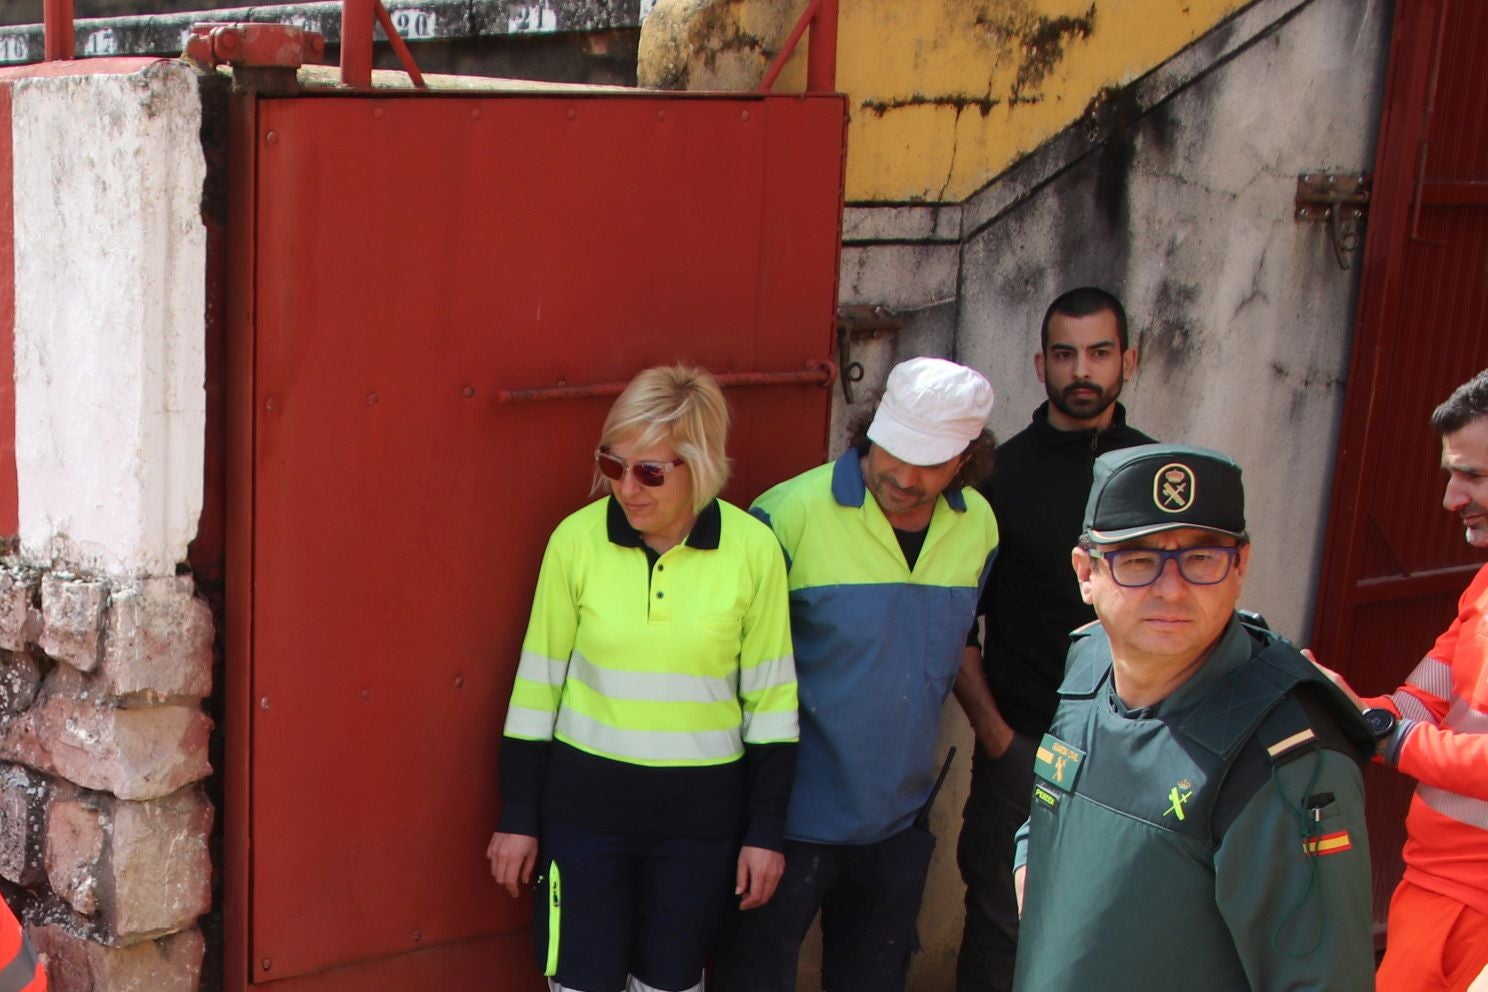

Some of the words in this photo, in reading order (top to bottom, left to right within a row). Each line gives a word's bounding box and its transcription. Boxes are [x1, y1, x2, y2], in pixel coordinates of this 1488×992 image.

[398, 13, 427, 36] 20
[2, 38, 24, 58] 16
[92, 33, 112, 53] 17
